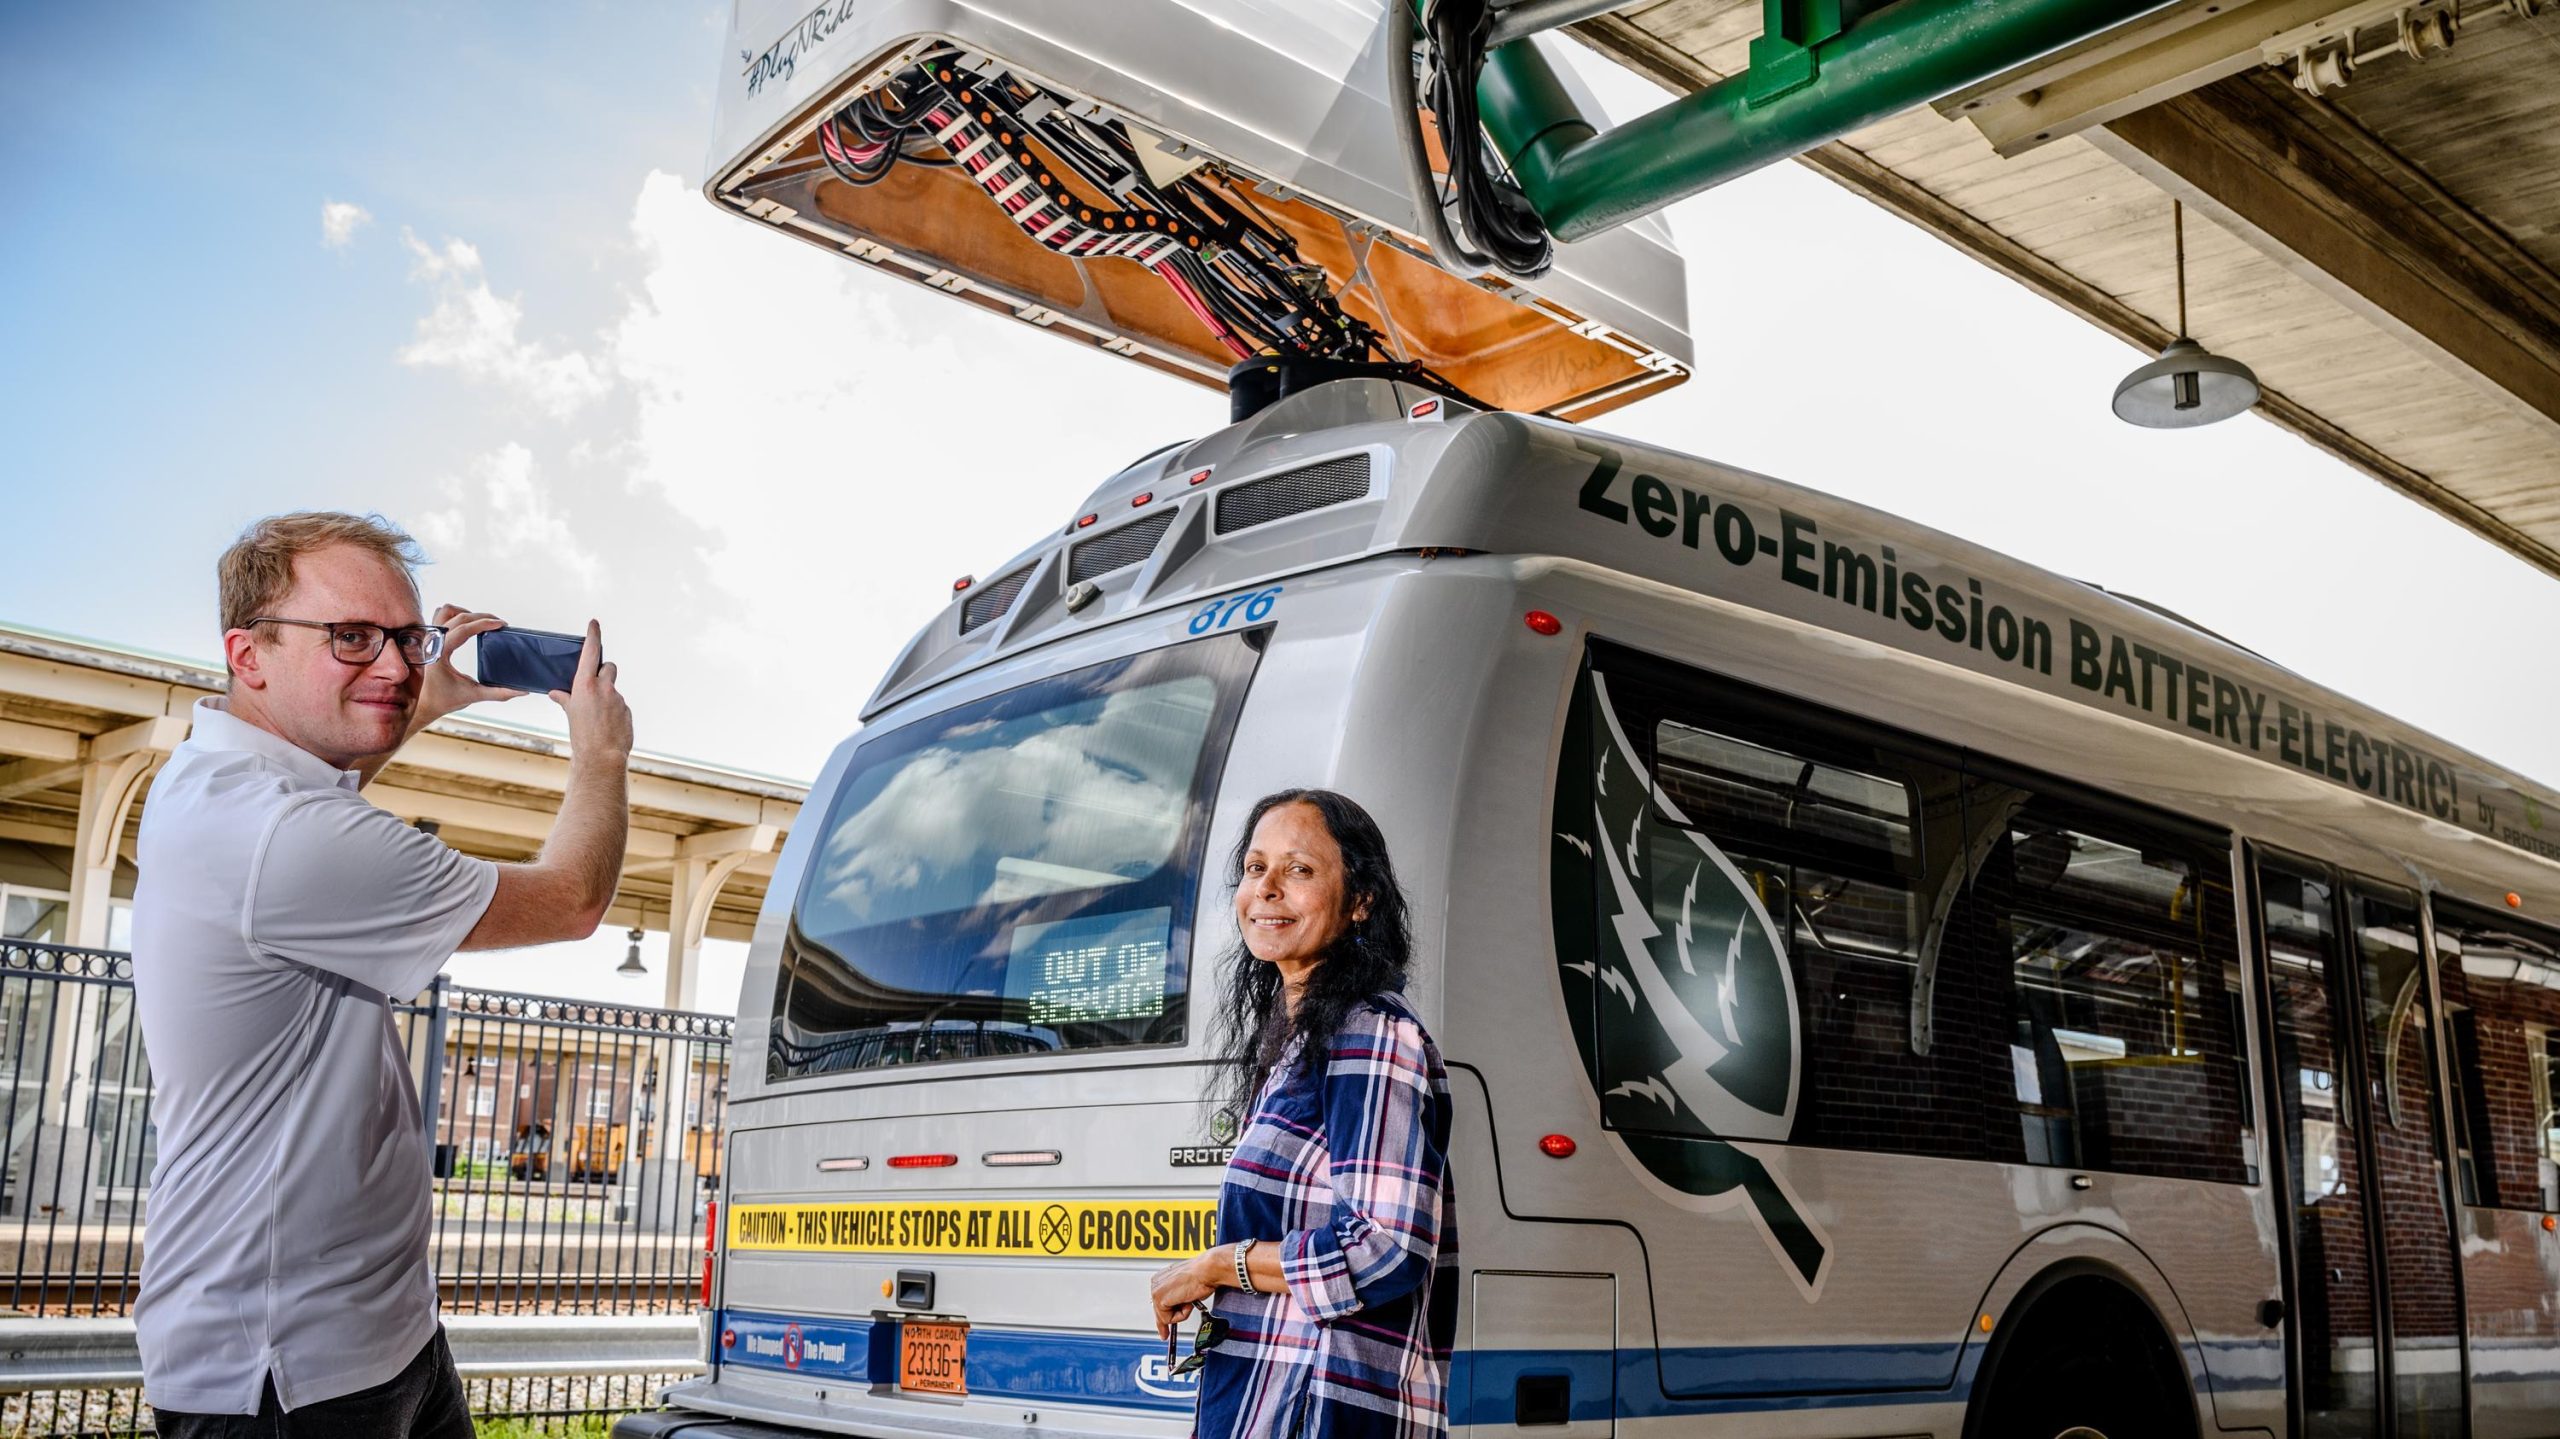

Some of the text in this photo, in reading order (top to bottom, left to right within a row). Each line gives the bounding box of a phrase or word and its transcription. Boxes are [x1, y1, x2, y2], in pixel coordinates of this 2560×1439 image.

[1188, 586, 1284, 635] 876
[1573, 436, 2496, 833] Zero-Emission BATTERY-ELECTRIC! by
[1045, 941, 1160, 985] OUT OF
[738, 1211, 787, 1245] CAUTION
[797, 1210, 828, 1246] THIS
[831, 1209, 896, 1247] VEHICLE
[899, 1209, 962, 1248] STOPS
[965, 1210, 993, 1248] AT
[995, 1210, 1034, 1249] ALL
[1078, 1209, 1217, 1251] CROSSING
[803, 1339, 818, 1360] The
[819, 1341, 846, 1364] Pump!
[904, 1326, 932, 1339] NORTH
[920, 1379, 954, 1389] PERMANENT
